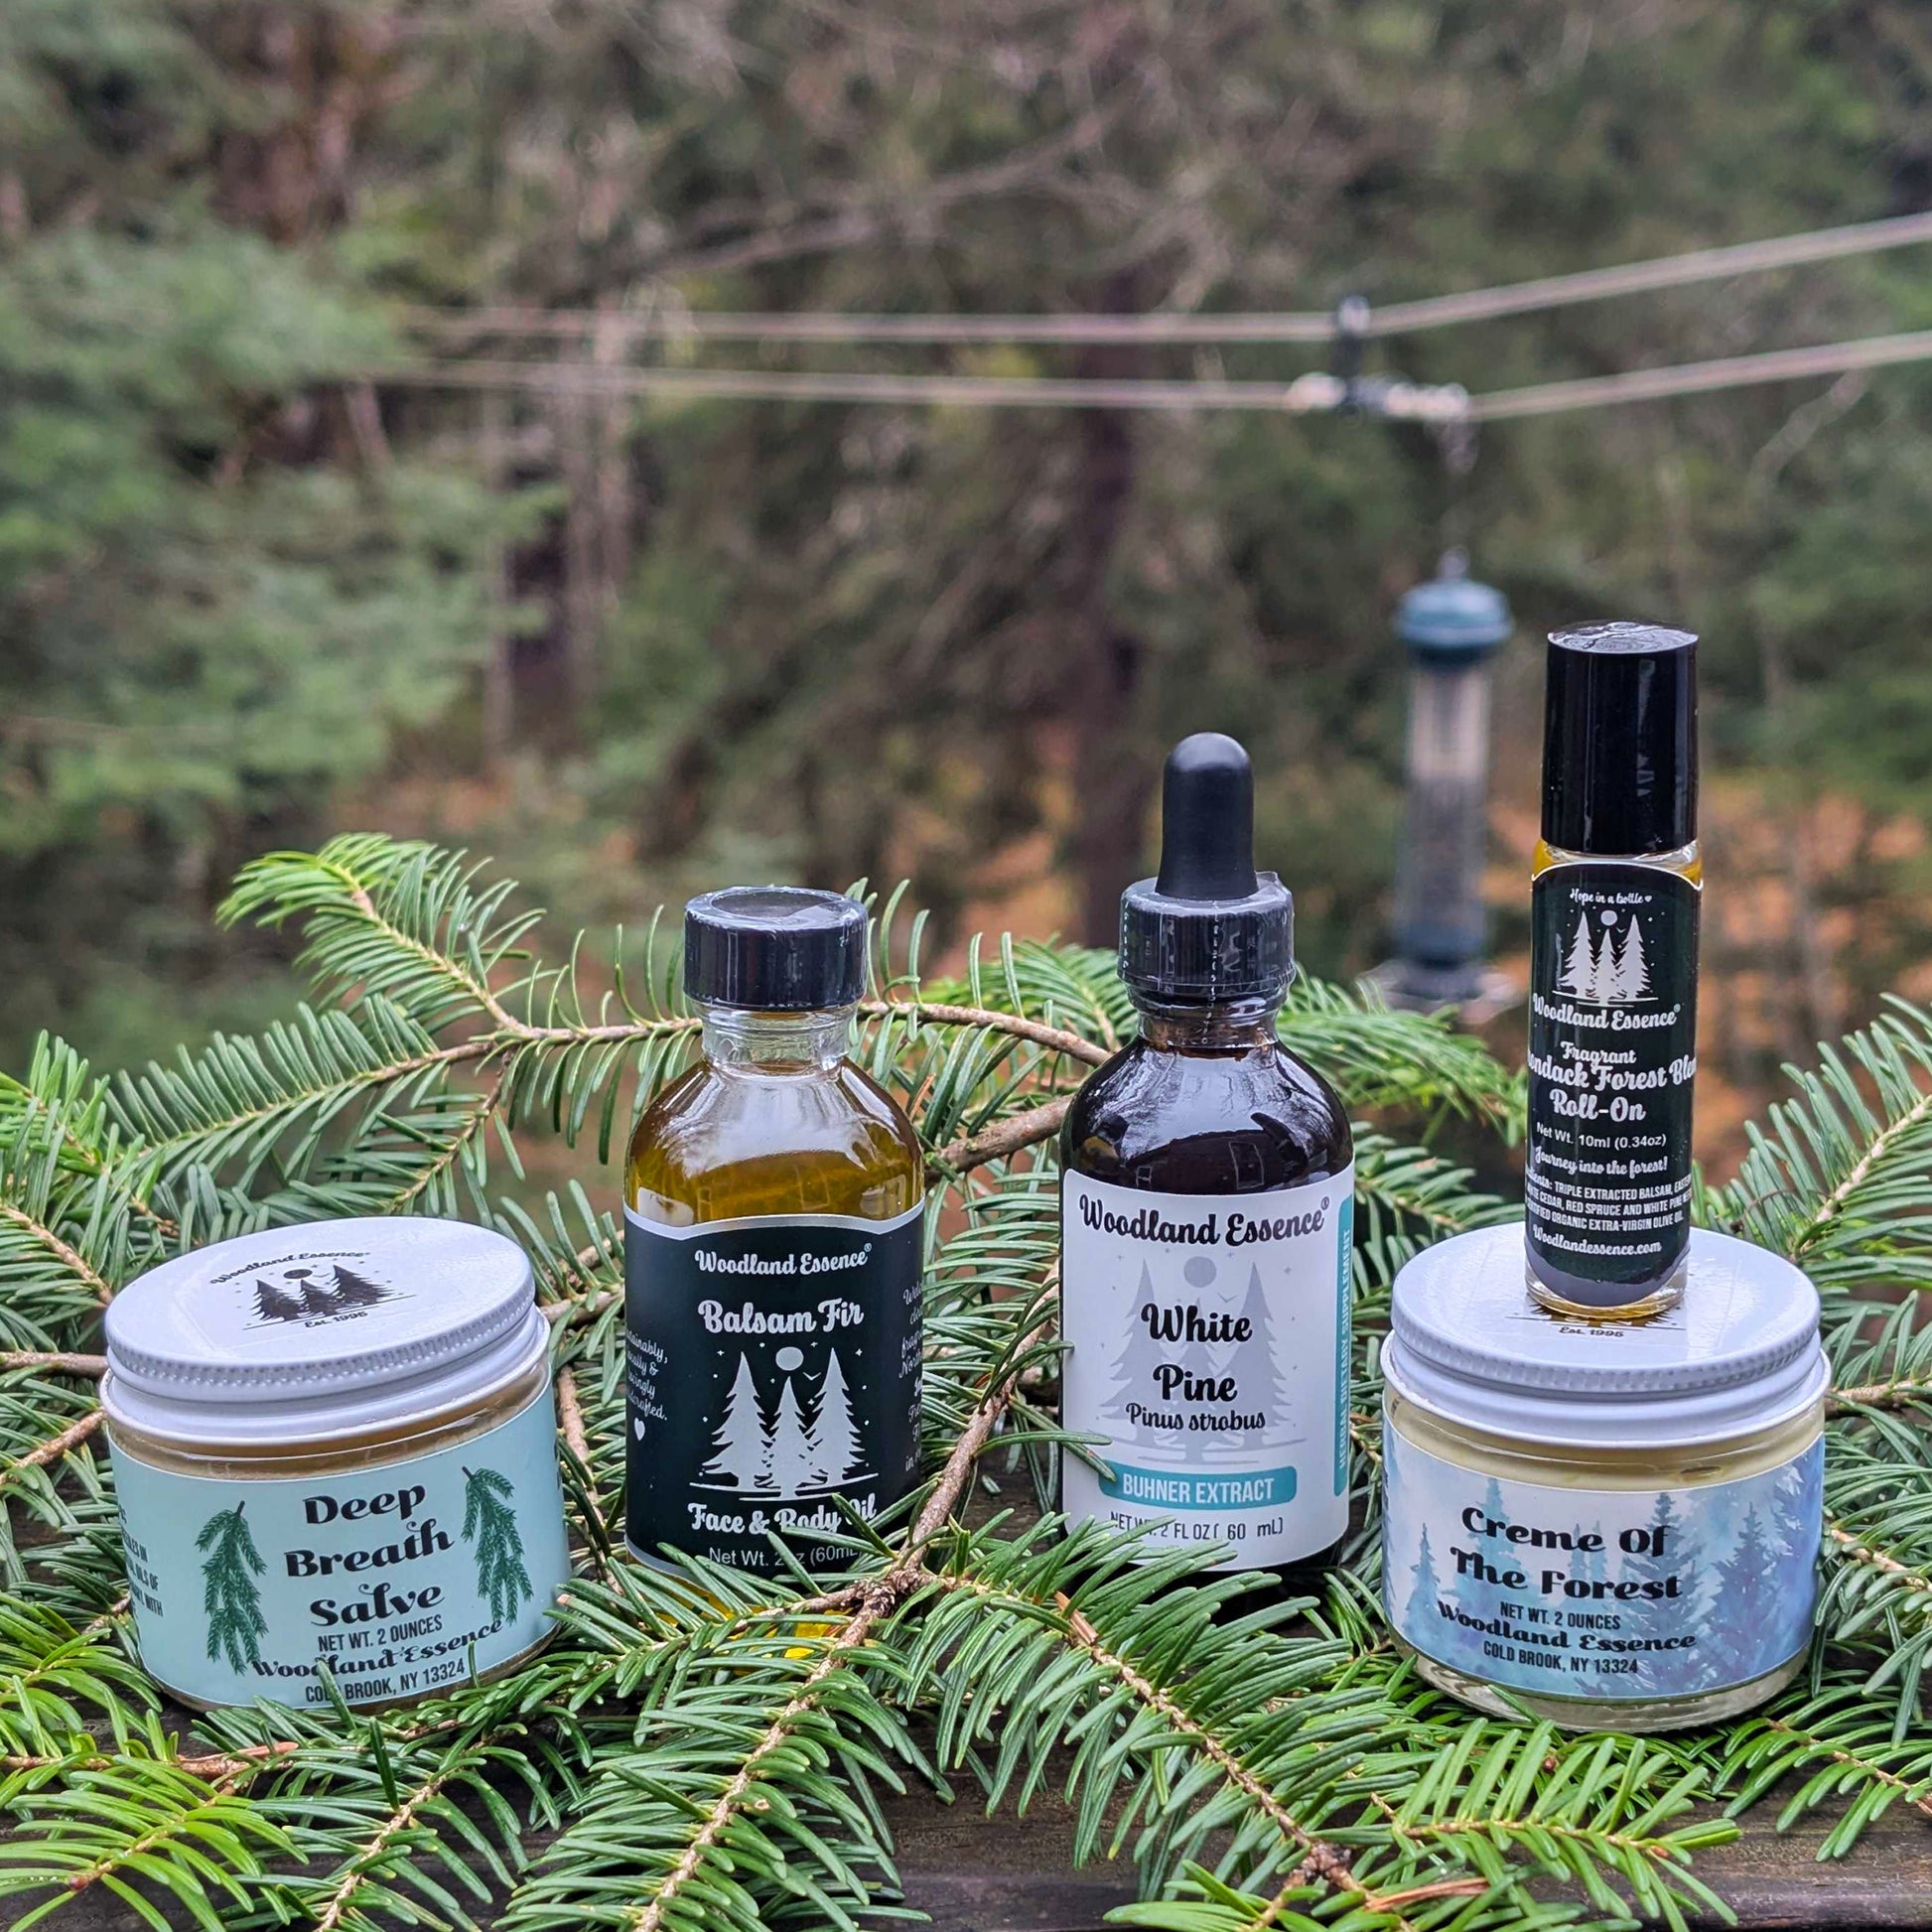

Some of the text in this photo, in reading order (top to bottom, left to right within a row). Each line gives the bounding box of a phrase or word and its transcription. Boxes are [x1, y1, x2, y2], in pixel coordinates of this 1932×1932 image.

[1570, 889, 1643, 906] Hope in a bottle
[1533, 993, 1609, 1030] Woodland
[1560, 1040, 1637, 1069] Fragrant
[1590, 1065, 1668, 1091] Forest
[1549, 1088, 1647, 1122] Roll-On
[1536, 1122, 1667, 1151] Net Wt. 10ml (0.34oz)
[1535, 1146, 1668, 1179] Journey into the forest!
[1540, 1191, 1564, 1211] CEDAR,
[1566, 1199, 1584, 1213] RED
[1585, 1202, 1621, 1216] SPRUCE
[1623, 1204, 1642, 1216] AND
[1643, 1199, 1668, 1214] WHITE
[1554, 1180, 1583, 1198] TRIPLE
[1585, 1187, 1637, 1201] EXTRACTED
[1079, 1193, 1220, 1245] Woodland
[1552, 1211, 1587, 1229] ORGANIC
[1588, 1218, 1652, 1232] EXTRA-VIRGIN
[1653, 1213, 1674, 1229] OLIVE
[1533, 1224, 1662, 1256] Woodlandessence.com
[210, 1255, 294, 1284] Woodland
[695, 1249, 797, 1275] Woodland
[698, 1298, 864, 1334] Balsam Fir
[1141, 1303, 1253, 1343] White
[649, 1361, 659, 1376] &
[1153, 1363, 1238, 1402] Pine
[1126, 1402, 1266, 1432] Pinus strobus
[303, 1485, 425, 1524] Deep
[1123, 1473, 1275, 1504] BUHNER EXTRACT
[687, 1502, 746, 1534] Face
[749, 1510, 770, 1535] &
[773, 1505, 843, 1534] Body
[1110, 1511, 1133, 1531] NET
[1161, 1525, 1169, 1538] 2
[1173, 1523, 1189, 1540] FL
[1257, 1517, 1284, 1537] mL)
[1461, 1507, 1672, 1557] Creme Of
[284, 1518, 455, 1577] Breath
[709, 1547, 737, 1566] Net
[741, 1550, 769, 1567] Wt.
[1449, 1547, 1683, 1600] The Forest
[310, 1583, 446, 1626] Salve
[1500, 1601, 1621, 1630] NET WT. 2 OUNCES
[318, 1614, 443, 1652] NET WT. 2 OUNCES
[399, 1619, 503, 1664] Essence
[1438, 1600, 1697, 1653] Woodland Essence
[1483, 1640, 1638, 1674] COLD BROOK, NY 13324
[306, 1658, 465, 1703] COL BROOK, NY 13324
